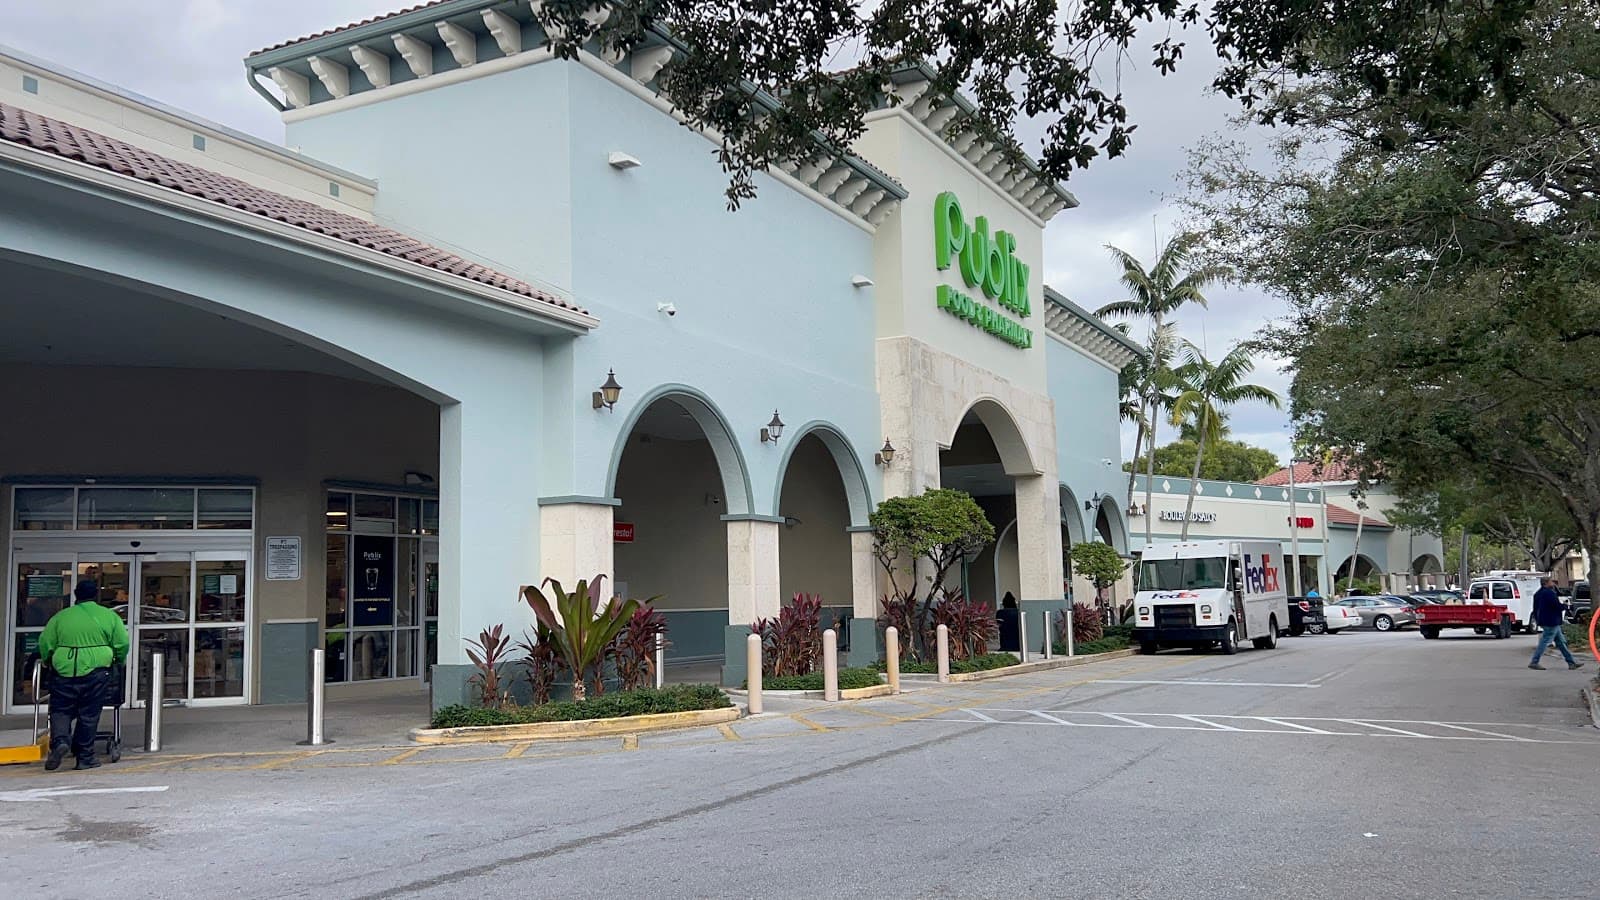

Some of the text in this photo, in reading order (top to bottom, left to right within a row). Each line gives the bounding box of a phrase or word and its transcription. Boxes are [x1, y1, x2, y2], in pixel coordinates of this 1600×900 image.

[934, 191, 1031, 318] Publix
[937, 285, 975, 325] FOOD
[980, 306, 1034, 349] PHARMACY
[1152, 592, 1200, 600] FedEx
[1244, 554, 1280, 594] FedEx
